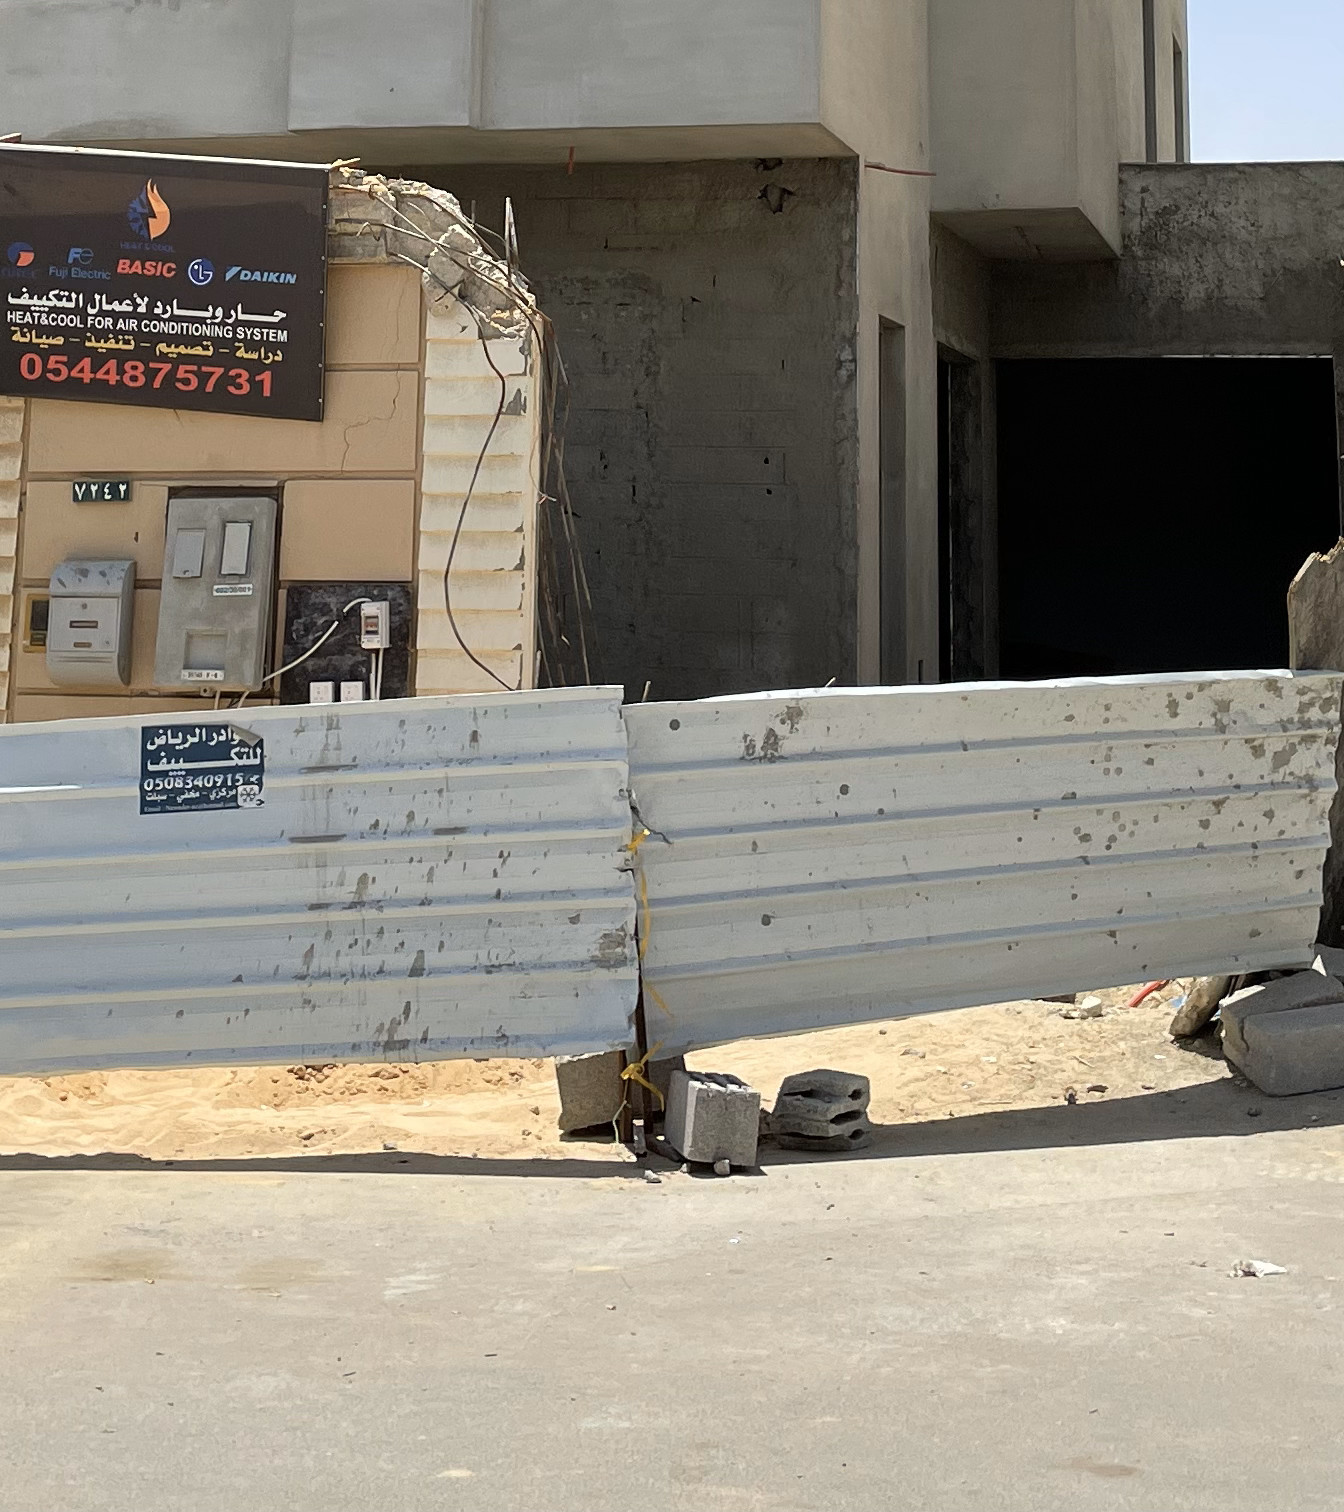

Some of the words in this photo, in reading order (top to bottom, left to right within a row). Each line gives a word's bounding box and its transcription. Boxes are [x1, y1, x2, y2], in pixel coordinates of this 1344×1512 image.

[49, 266, 69, 280] Fuji
[71, 267, 112, 281] Electric
[116, 258, 177, 278] BASIC
[240, 270, 297, 285] DAIKIN
[7, 286, 84, 312] التكييف
[87, 292, 149, 315] لأعمال
[7, 310, 84, 328] HEAT&COOL
[87, 315, 113, 330] FOR
[116, 318, 139, 331] AIR
[141, 319, 233, 338] CONDITIONING
[236, 326, 288, 342] SYSTEM
[11, 326, 65, 349] صيانة
[85, 331, 136, 353] تنفيذ
[155, 340, 214, 358] تصميم
[234, 341, 283, 365] دراسة
[19, 352, 272, 397] 0544875731
[146, 726, 206, 751] الرياض
[147, 746, 262, 776] للتكييف
[143, 772, 244, 792] 0508340915
[208, 787, 237, 801] مركزي
